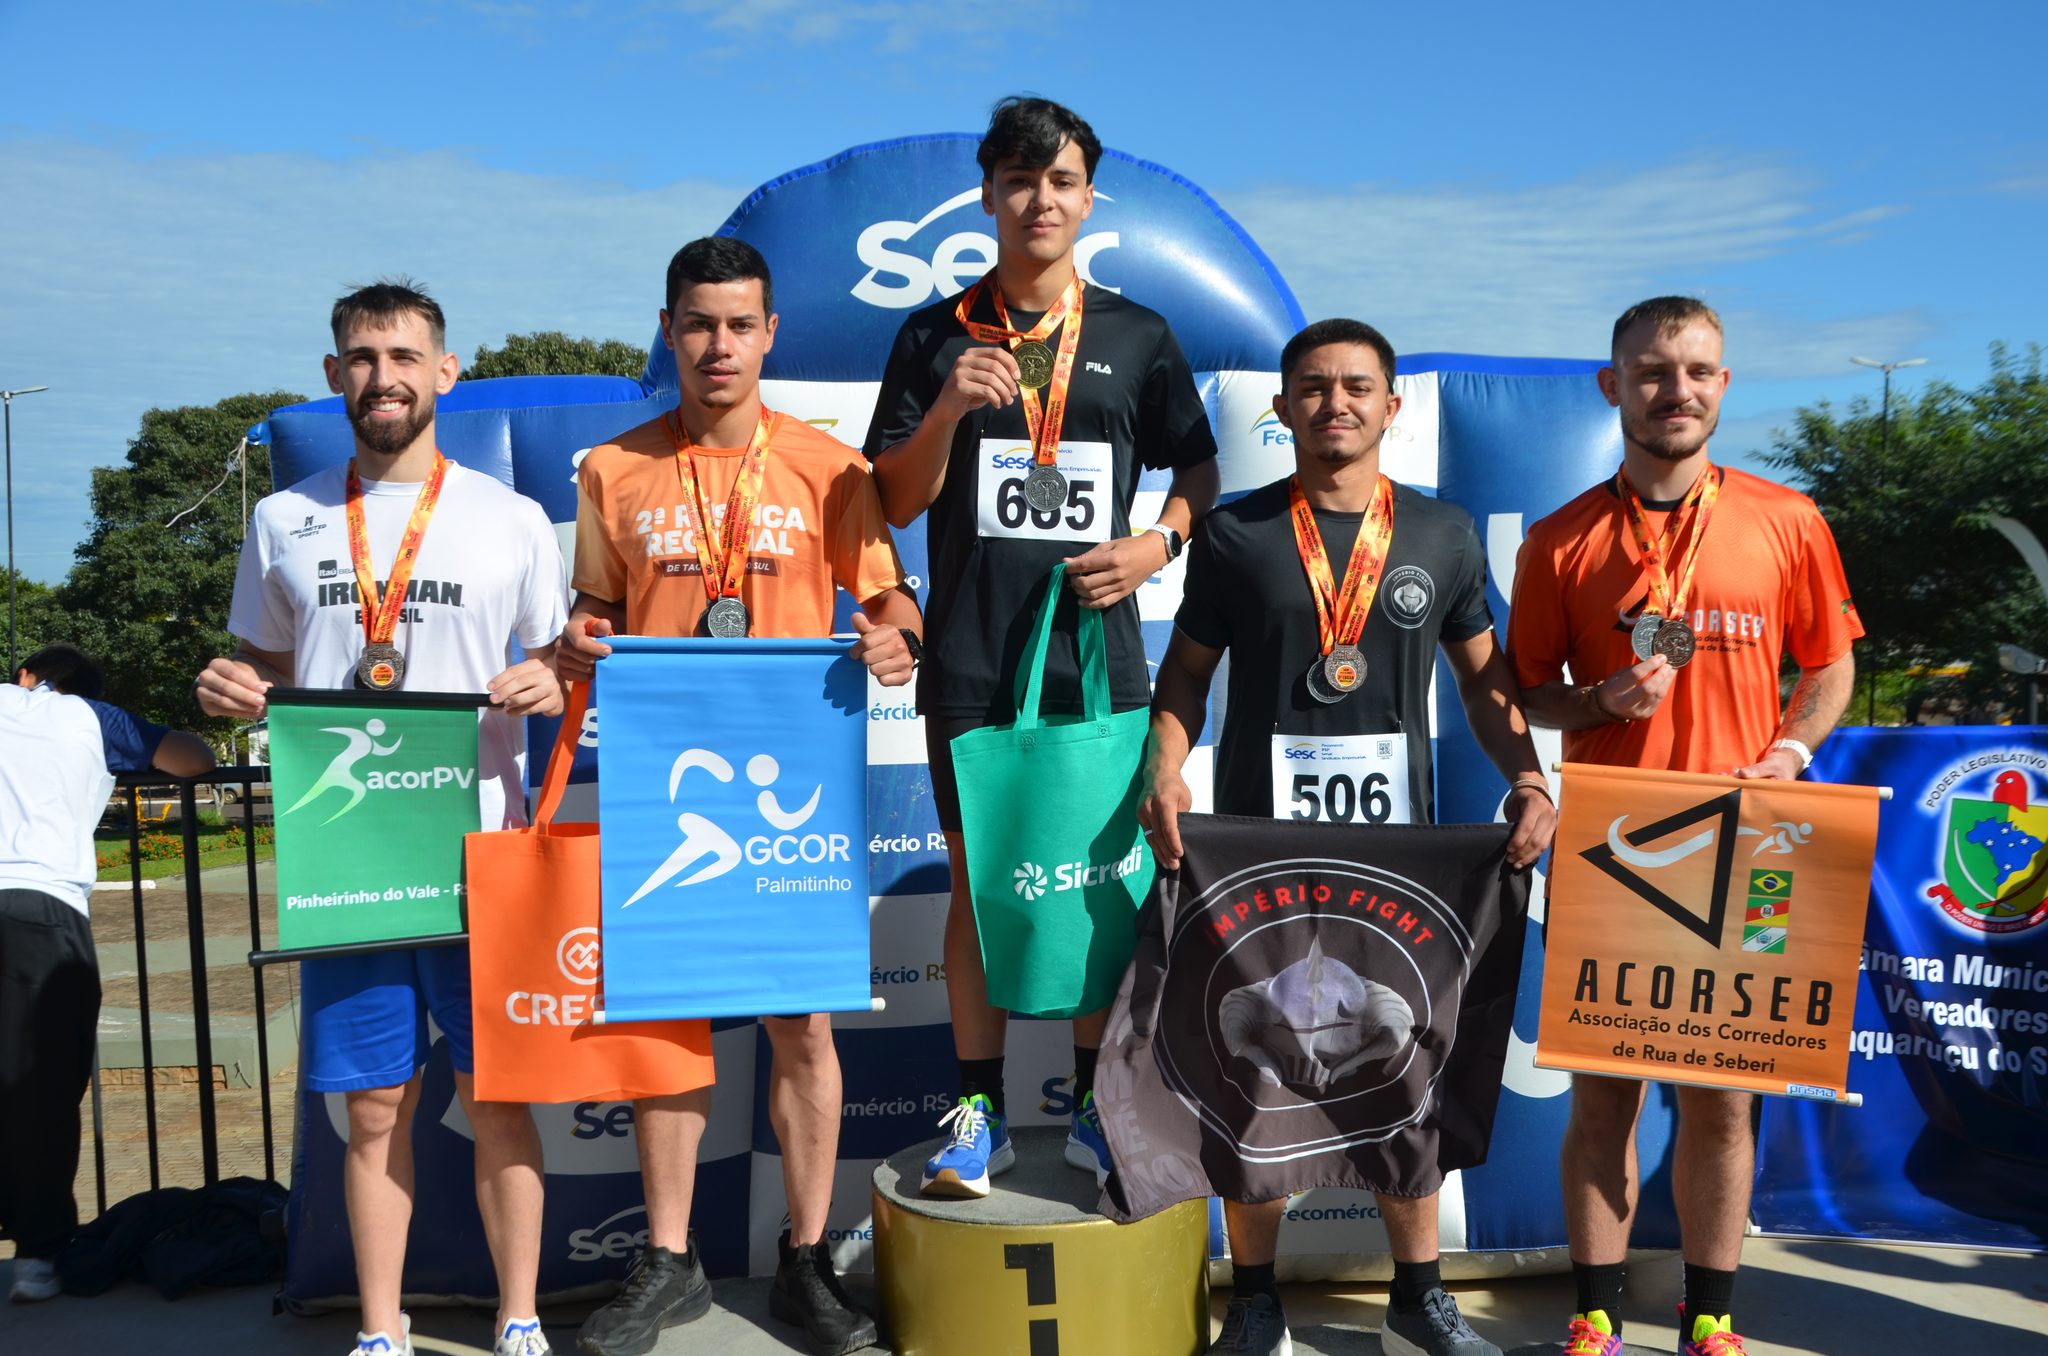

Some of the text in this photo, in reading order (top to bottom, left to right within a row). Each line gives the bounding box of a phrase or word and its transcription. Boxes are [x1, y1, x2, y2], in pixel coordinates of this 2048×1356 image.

[851, 220, 1121, 310] Sec
[1086, 362, 1112, 374] FILA
[992, 455, 1037, 470] Sesc
[319, 568, 336, 577] Itaú
[666, 563, 680, 572] DE
[753, 561, 770, 571] SUL
[1684, 609, 1765, 638] ORSEB
[1285, 748, 1316, 760] Sesc
[366, 766, 475, 790] acorPV
[1926, 753, 2046, 808] PODER LEGISLATIVO
[1290, 772, 1391, 823] 506
[745, 833, 850, 866] GCOR
[1055, 845, 1142, 891] Sicredi
[286, 890, 380, 910] Pinheirinho
[383, 887, 404, 902] do
[406, 884, 440, 899] Vale
[756, 876, 852, 893] Palmitinho
[1204, 884, 1434, 946] IMPÉRIO FIGHT
[1574, 958, 1832, 1026] ACORSEB
[1568, 1008, 1827, 1051] Associação dos Corredores
[1612, 1041, 1775, 1075] de Rua de Seberi
[1988, 1041, 2021, 1073] do
[570, 1101, 634, 1139] Se
[843, 1093, 949, 1116] mércio RS
